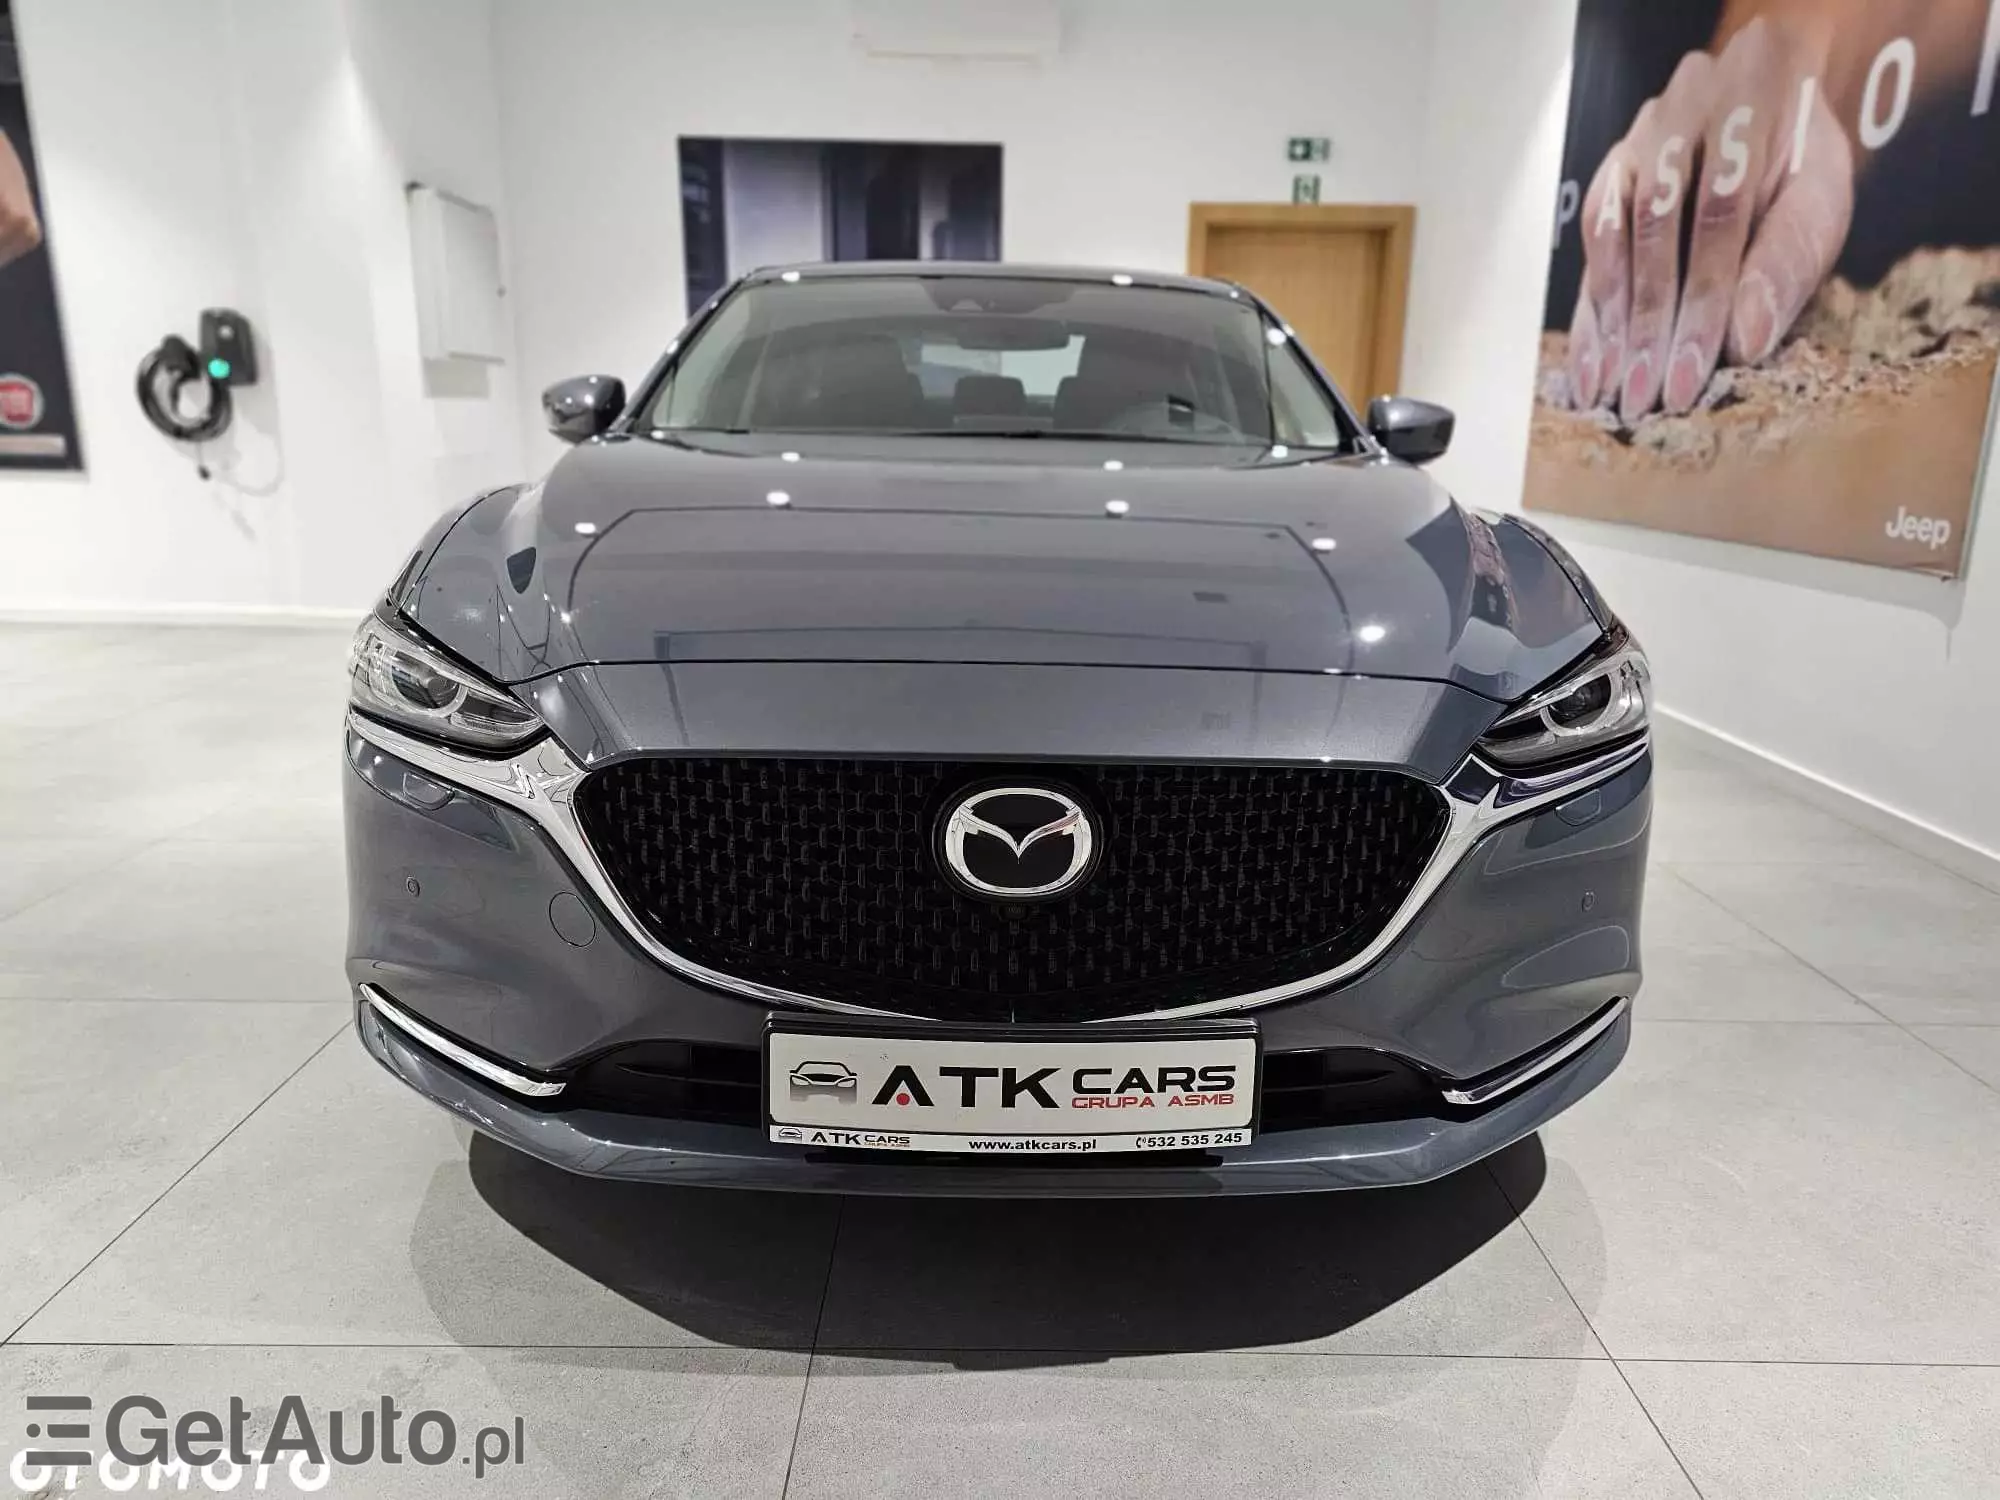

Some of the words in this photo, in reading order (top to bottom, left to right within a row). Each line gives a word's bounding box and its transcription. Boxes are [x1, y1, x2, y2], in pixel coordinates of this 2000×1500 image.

[1885, 505, 1952, 550] Jeep
[871, 1065, 1061, 1109] ATK
[1072, 1065, 1236, 1095] CARS
[1071, 1096, 1155, 1109] GRUPA
[1167, 1093, 1234, 1107] ASMB
[810, 1131, 861, 1145] ATK
[864, 1134, 910, 1144] CARS
[968, 1138, 1097, 1152] www.atkcars.pl
[1147, 1136, 1176, 1148] 532
[1180, 1135, 1209, 1146] 535
[1214, 1133, 1242, 1144] 245
